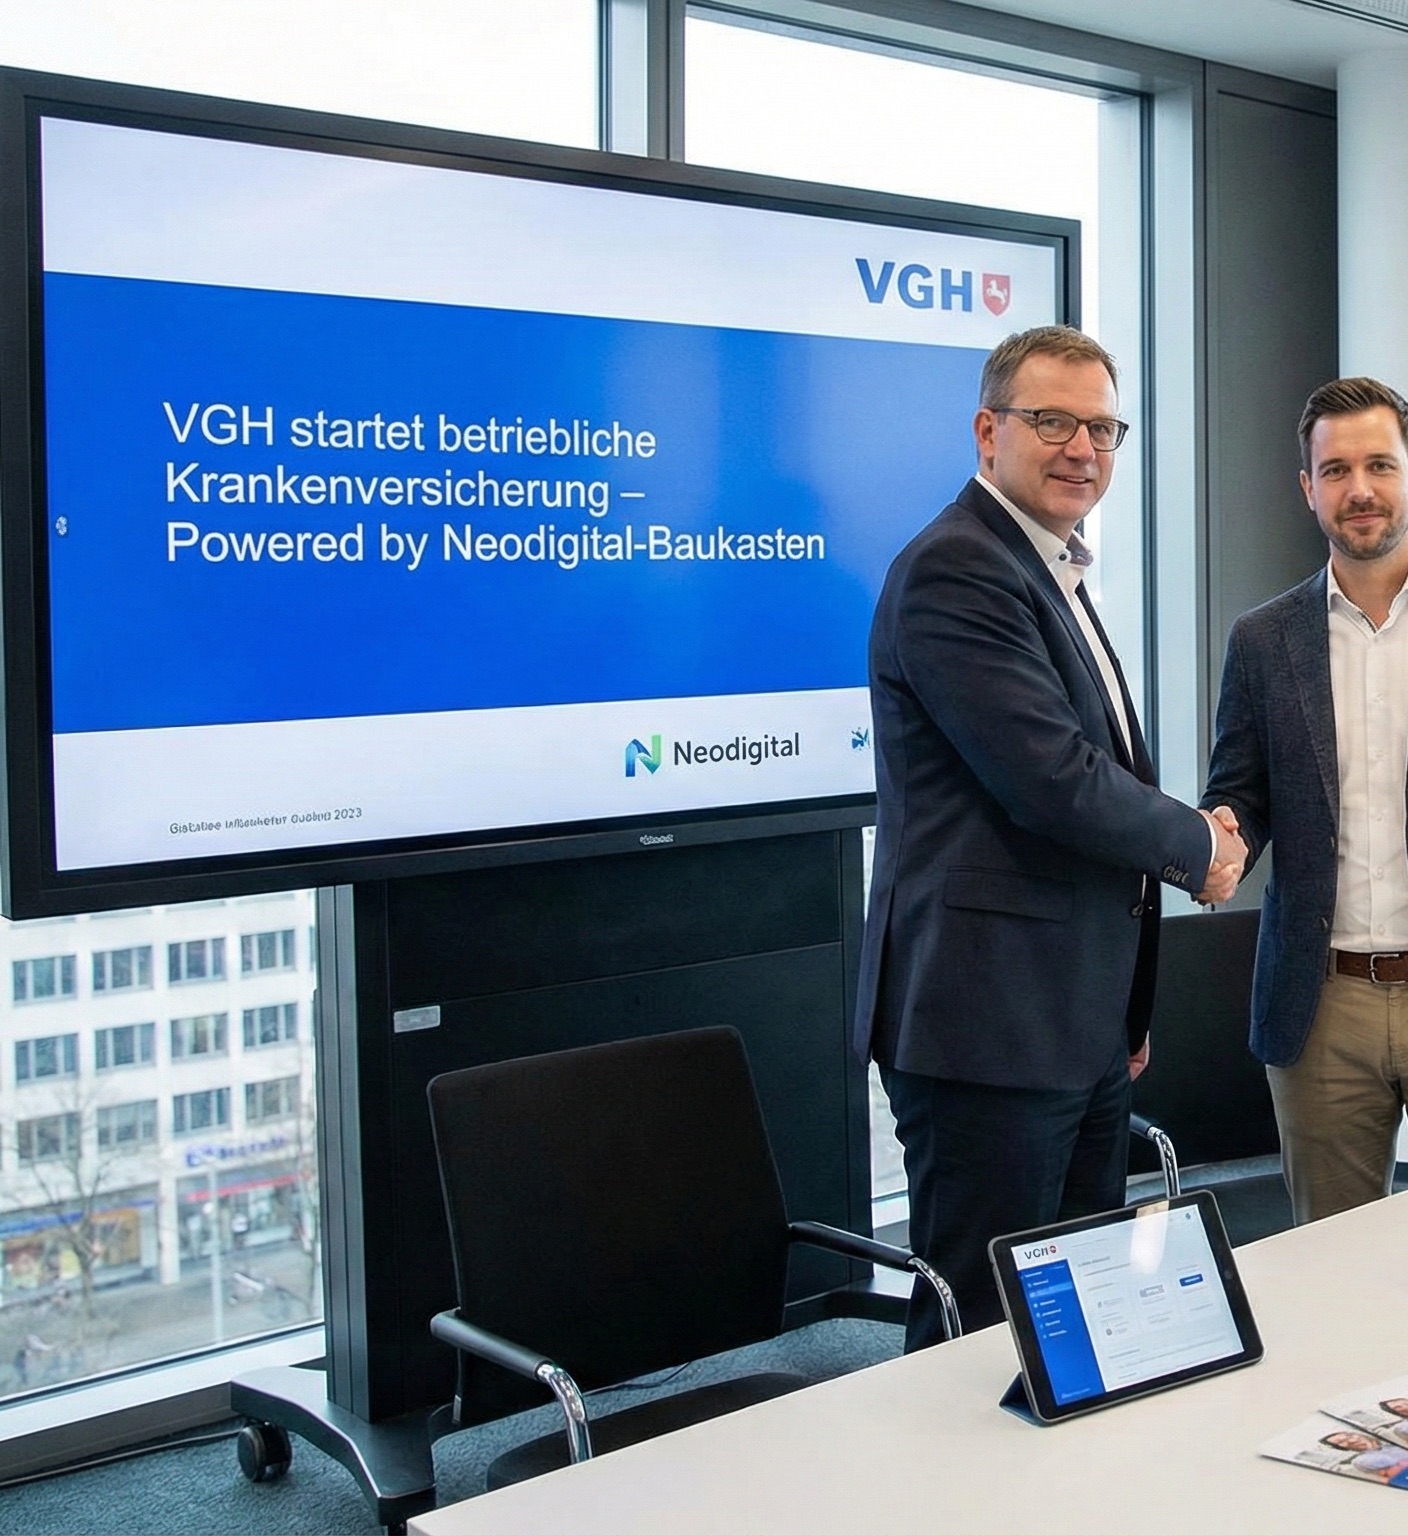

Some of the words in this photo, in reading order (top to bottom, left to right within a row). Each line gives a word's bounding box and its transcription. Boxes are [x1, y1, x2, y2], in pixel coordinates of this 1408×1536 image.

[855, 257, 973, 313] VGH
[162, 401, 274, 446] VGH
[290, 410, 426, 451] startet
[438, 413, 657, 459] betriebliche
[165, 461, 610, 518] Krankenversicherung
[166, 521, 364, 563] Powered
[380, 522, 429, 572] by
[443, 523, 826, 570] Neodigital-Baukasten
[673, 732, 801, 766] Neodigital
[333, 806, 363, 821] 2023
